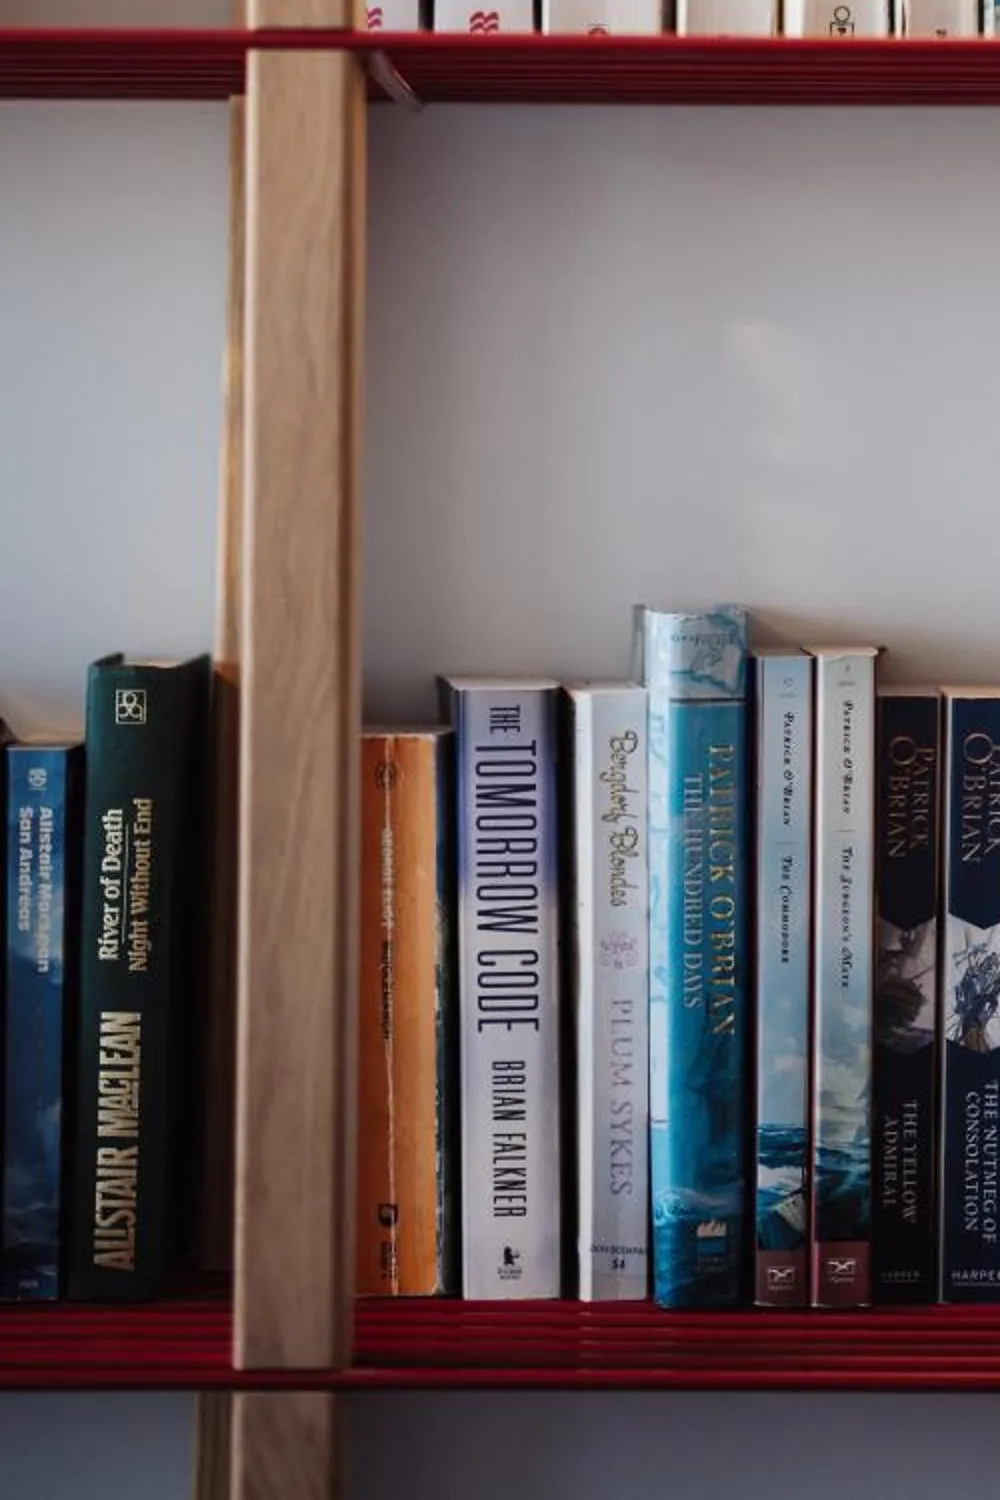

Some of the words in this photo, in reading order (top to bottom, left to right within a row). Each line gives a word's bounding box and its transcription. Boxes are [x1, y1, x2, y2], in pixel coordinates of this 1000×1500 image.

[489, 704, 522, 733] THE
[132, 797, 153, 835] End
[600, 730, 640, 824] Bergdorf
[709, 744, 736, 883] PATRICK
[888, 736, 917, 858] O'BRIAN
[911, 747, 936, 850] PATRICK
[962, 732, 996, 866] O'BRIAN
[19, 805, 34, 844] San
[37, 805, 54, 880] Alistair
[101, 809, 123, 872] Death
[474, 740, 539, 934] TOMORROW
[609, 826, 640, 908] Blondes
[18, 847, 34, 932] Andreas
[100, 876, 121, 900] of
[129, 839, 151, 915] Without
[97, 902, 121, 961] River
[128, 919, 153, 972] Night
[709, 896, 736, 1037] O'BRIAN
[475, 949, 540, 1034] CODE
[684, 952, 702, 1010] DAYS
[97, 1011, 142, 1138] MACLEAN
[611, 999, 635, 1088] PLUM
[490, 1059, 526, 1122] BRIAN
[903, 1099, 918, 1140] THE
[984, 1079, 999, 1120] THE
[492, 1132, 528, 1220] FALKNER
[609, 1100, 635, 1197] SYKES
[883, 1116, 900, 1207] ADMIRAL
[901, 1143, 918, 1223] YELLOW
[964, 1091, 981, 1233] CONSOLATION
[983, 1124, 998, 1214] NUTMEG
[93, 1145, 139, 1271] ALISTAIR
[982, 1217, 998, 1244] OF
